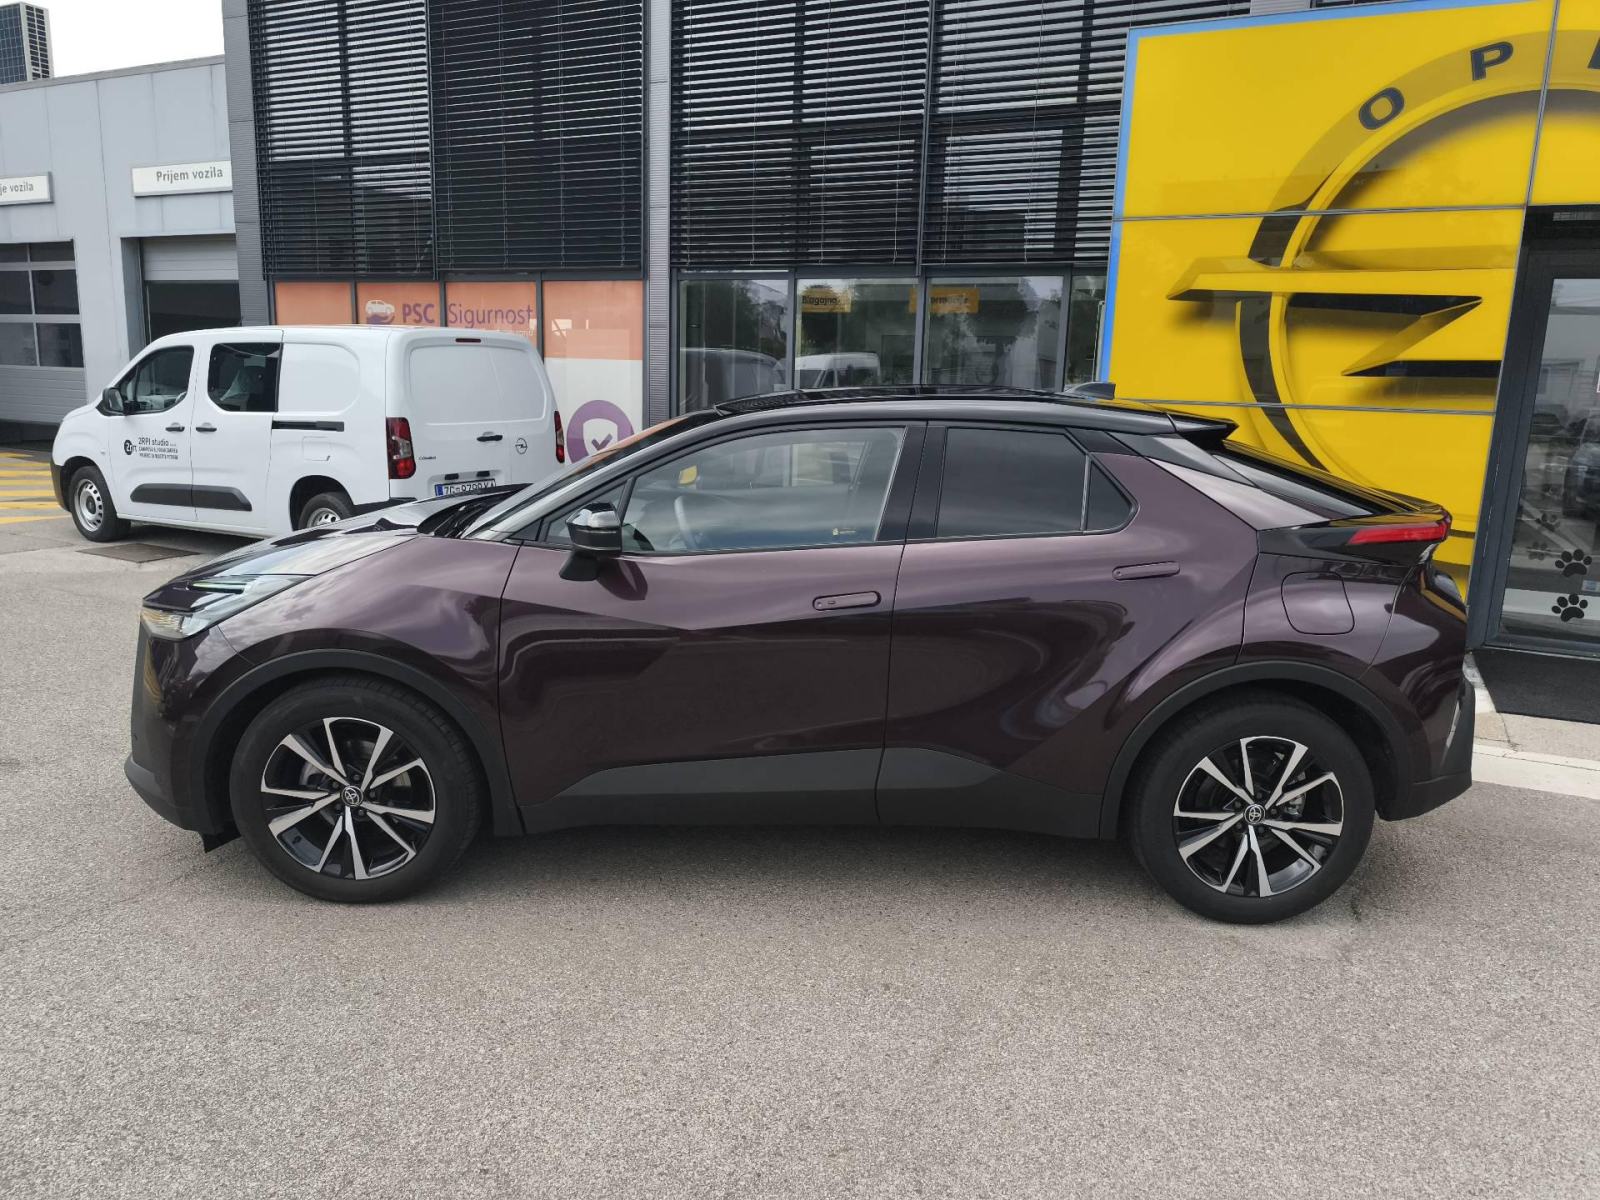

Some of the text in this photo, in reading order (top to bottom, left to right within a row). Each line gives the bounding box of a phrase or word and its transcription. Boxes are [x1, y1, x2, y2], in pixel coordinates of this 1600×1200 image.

[156, 166, 223, 184] Prijem vozila
[10, 180, 34, 192] vozila
[402, 303, 533, 329] PSC Sigurnost
[152, 438, 168, 446] studio
